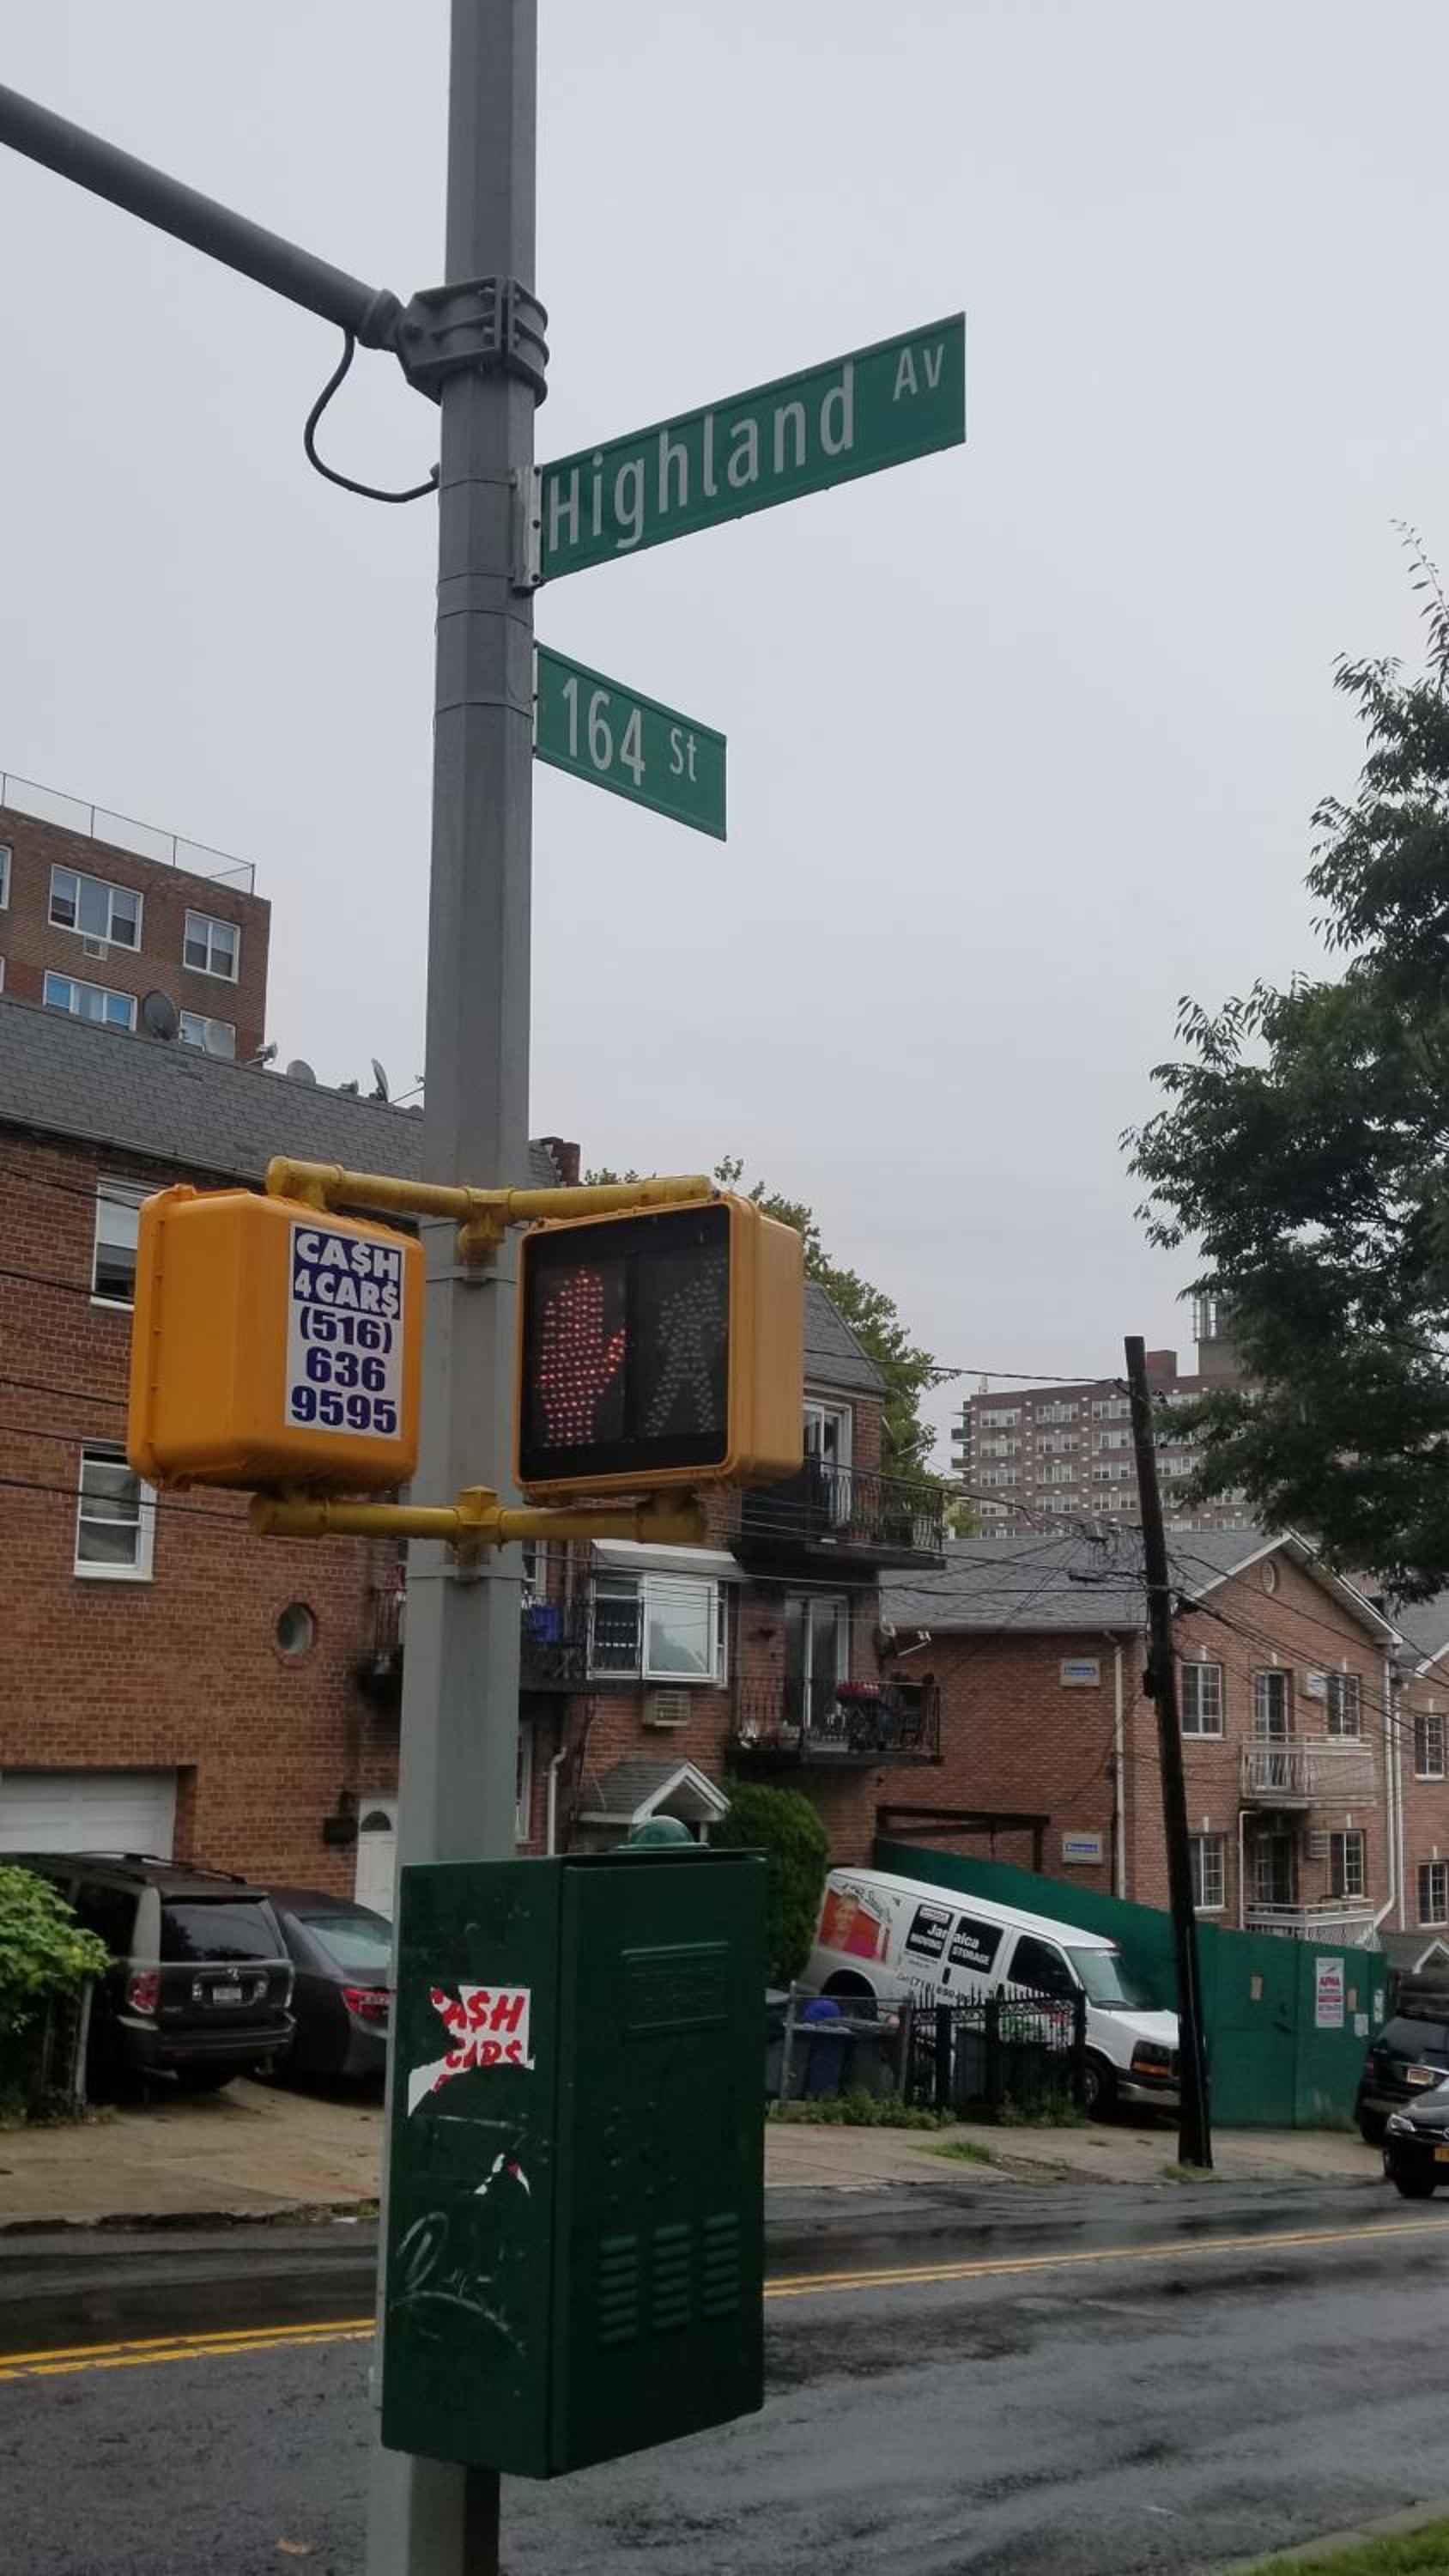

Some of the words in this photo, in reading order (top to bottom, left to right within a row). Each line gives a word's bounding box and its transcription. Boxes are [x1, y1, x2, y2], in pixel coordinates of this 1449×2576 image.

[549, 358, 855, 550] Highland
[893, 344, 944, 401] Av
[561, 677, 646, 787] 164
[669, 727, 698, 782] St
[300, 1306, 392, 1354] (516)
[306, 1346, 386, 1392] 636
[291, 1385, 397, 1435] 9595
